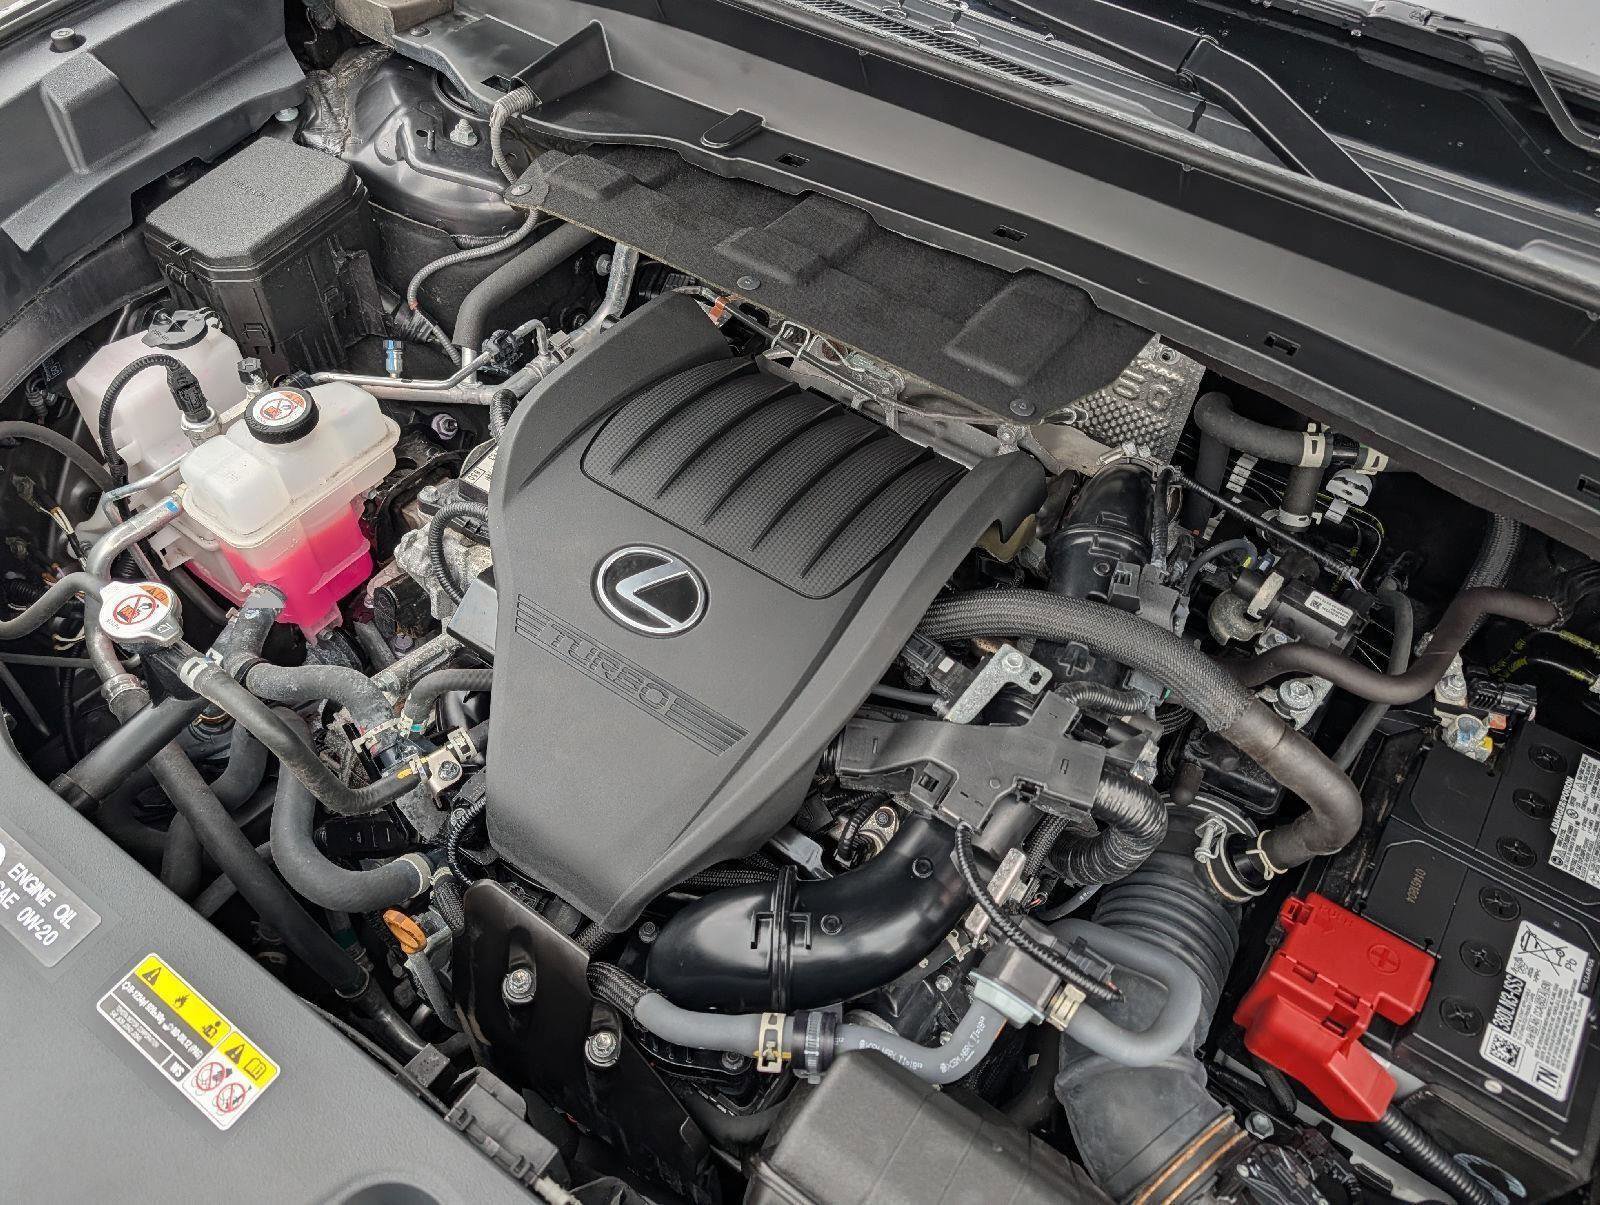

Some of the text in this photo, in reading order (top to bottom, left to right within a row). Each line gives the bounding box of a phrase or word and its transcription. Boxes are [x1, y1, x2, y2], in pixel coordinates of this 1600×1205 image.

[547, 621, 670, 709] TURBO
[7, 862, 78, 930] ENGINE OIL
[16, 906, 59, 946] 0W-20
[1565, 958, 1578, 973] Pb
[1492, 974, 1524, 1032] 380LN3-ISS
[1535, 1066, 1559, 1089] TN
